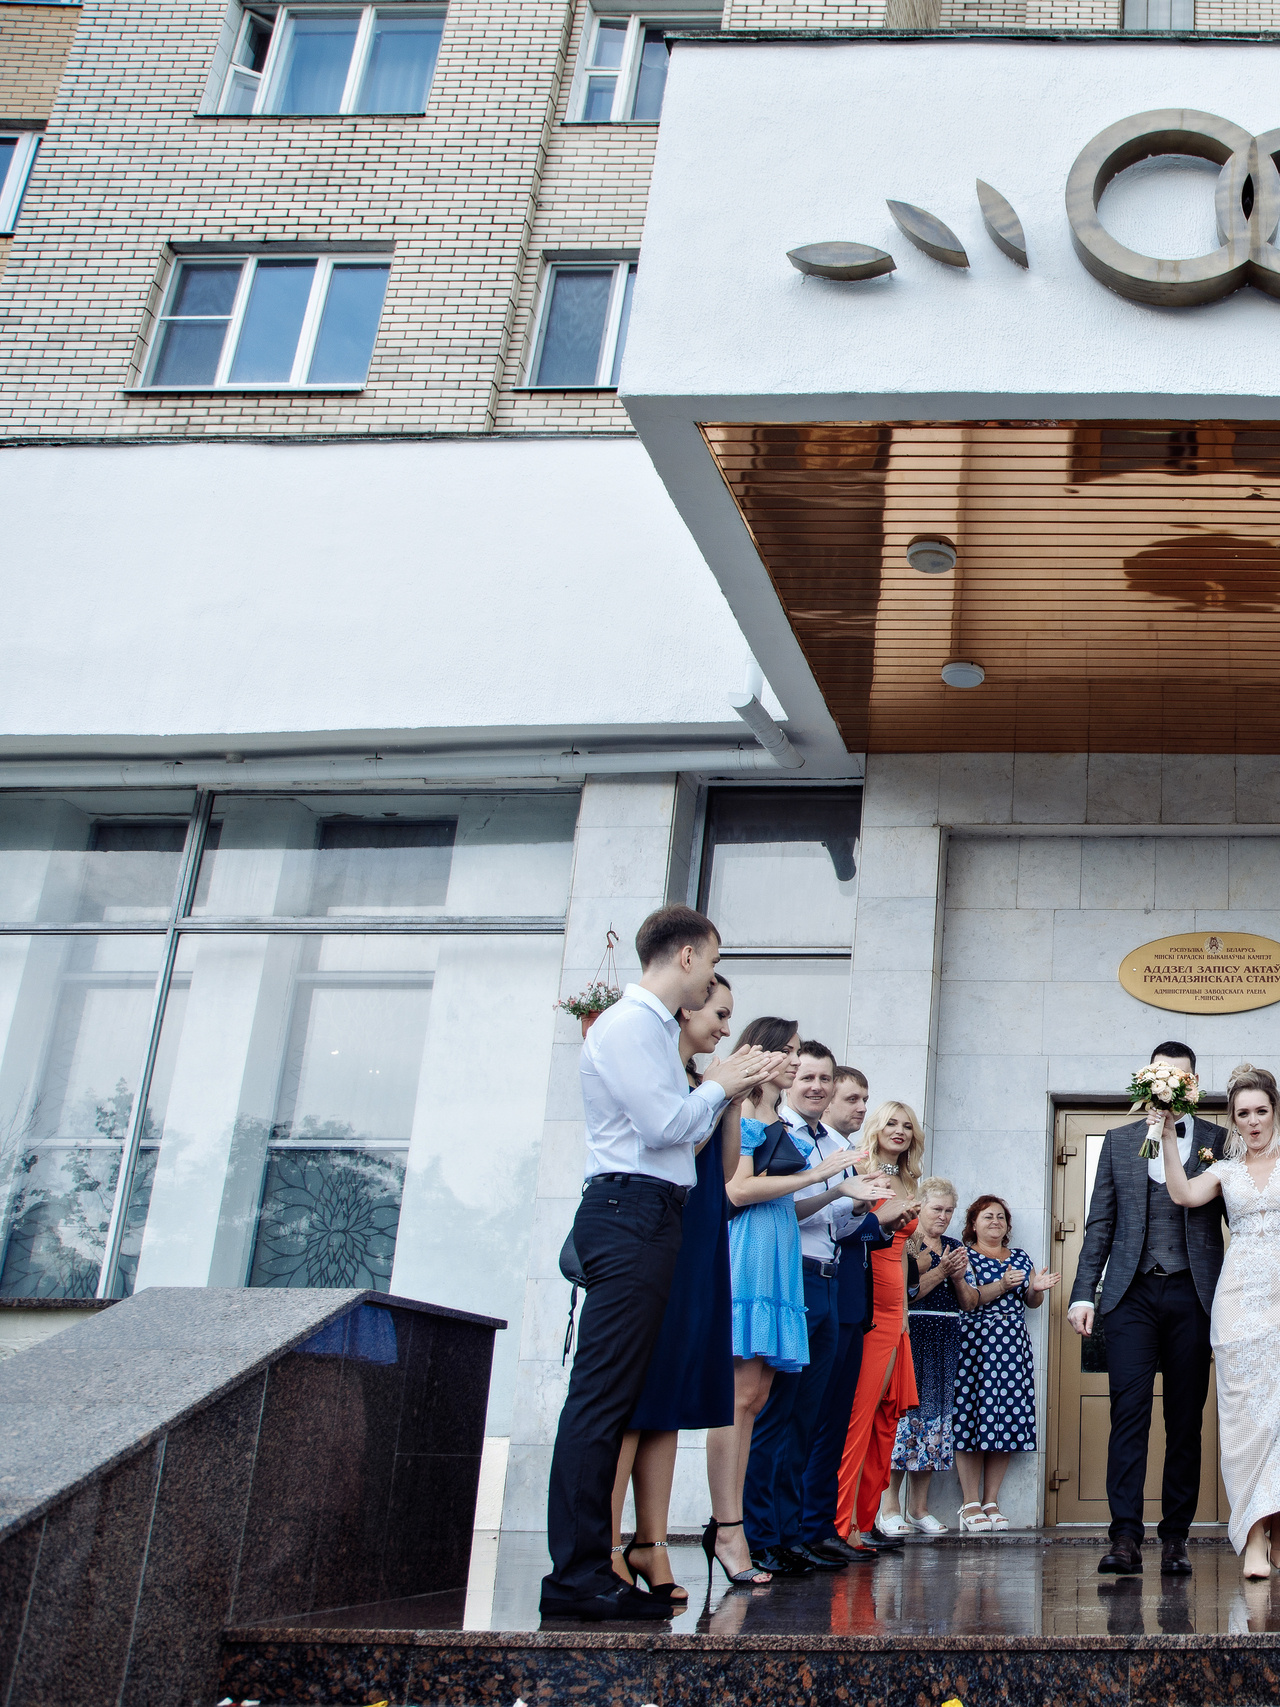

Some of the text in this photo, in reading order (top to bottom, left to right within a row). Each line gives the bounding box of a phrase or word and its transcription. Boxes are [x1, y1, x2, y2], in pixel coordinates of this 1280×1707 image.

[1144, 966, 1193, 974] АДДЗЕЛ
[1244, 964, 1280, 973] АКТАЎ
[1144, 975, 1280, 983] ГРАМАДЗЯНСКАГА СТАНУ
